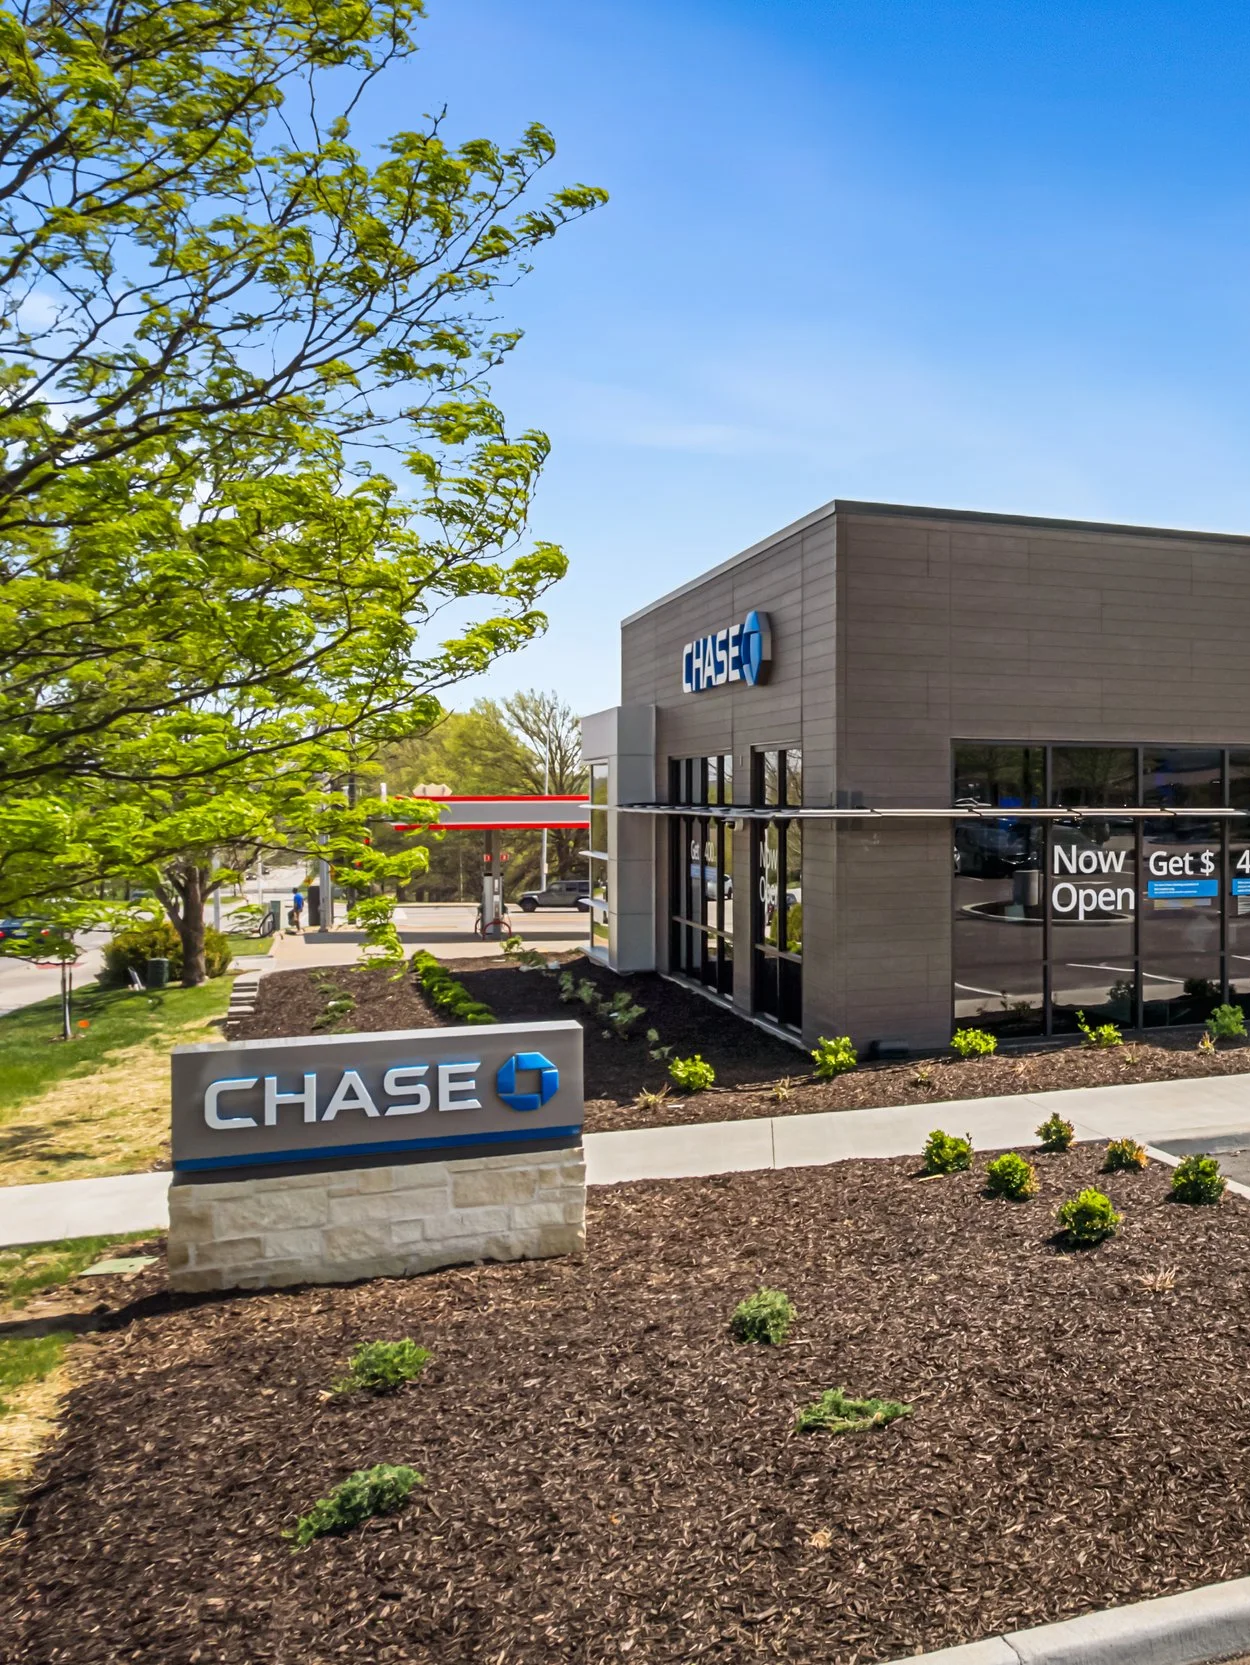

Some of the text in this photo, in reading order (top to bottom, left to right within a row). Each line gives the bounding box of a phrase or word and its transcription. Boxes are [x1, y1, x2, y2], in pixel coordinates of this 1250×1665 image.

[682, 623, 741, 694] CHASE
[1053, 844, 1126, 874] Now
[1149, 850, 1194, 876] Get
[1200, 849, 1215, 877] $
[1052, 882, 1135, 920] Open
[204, 1062, 482, 1130] CHASE
